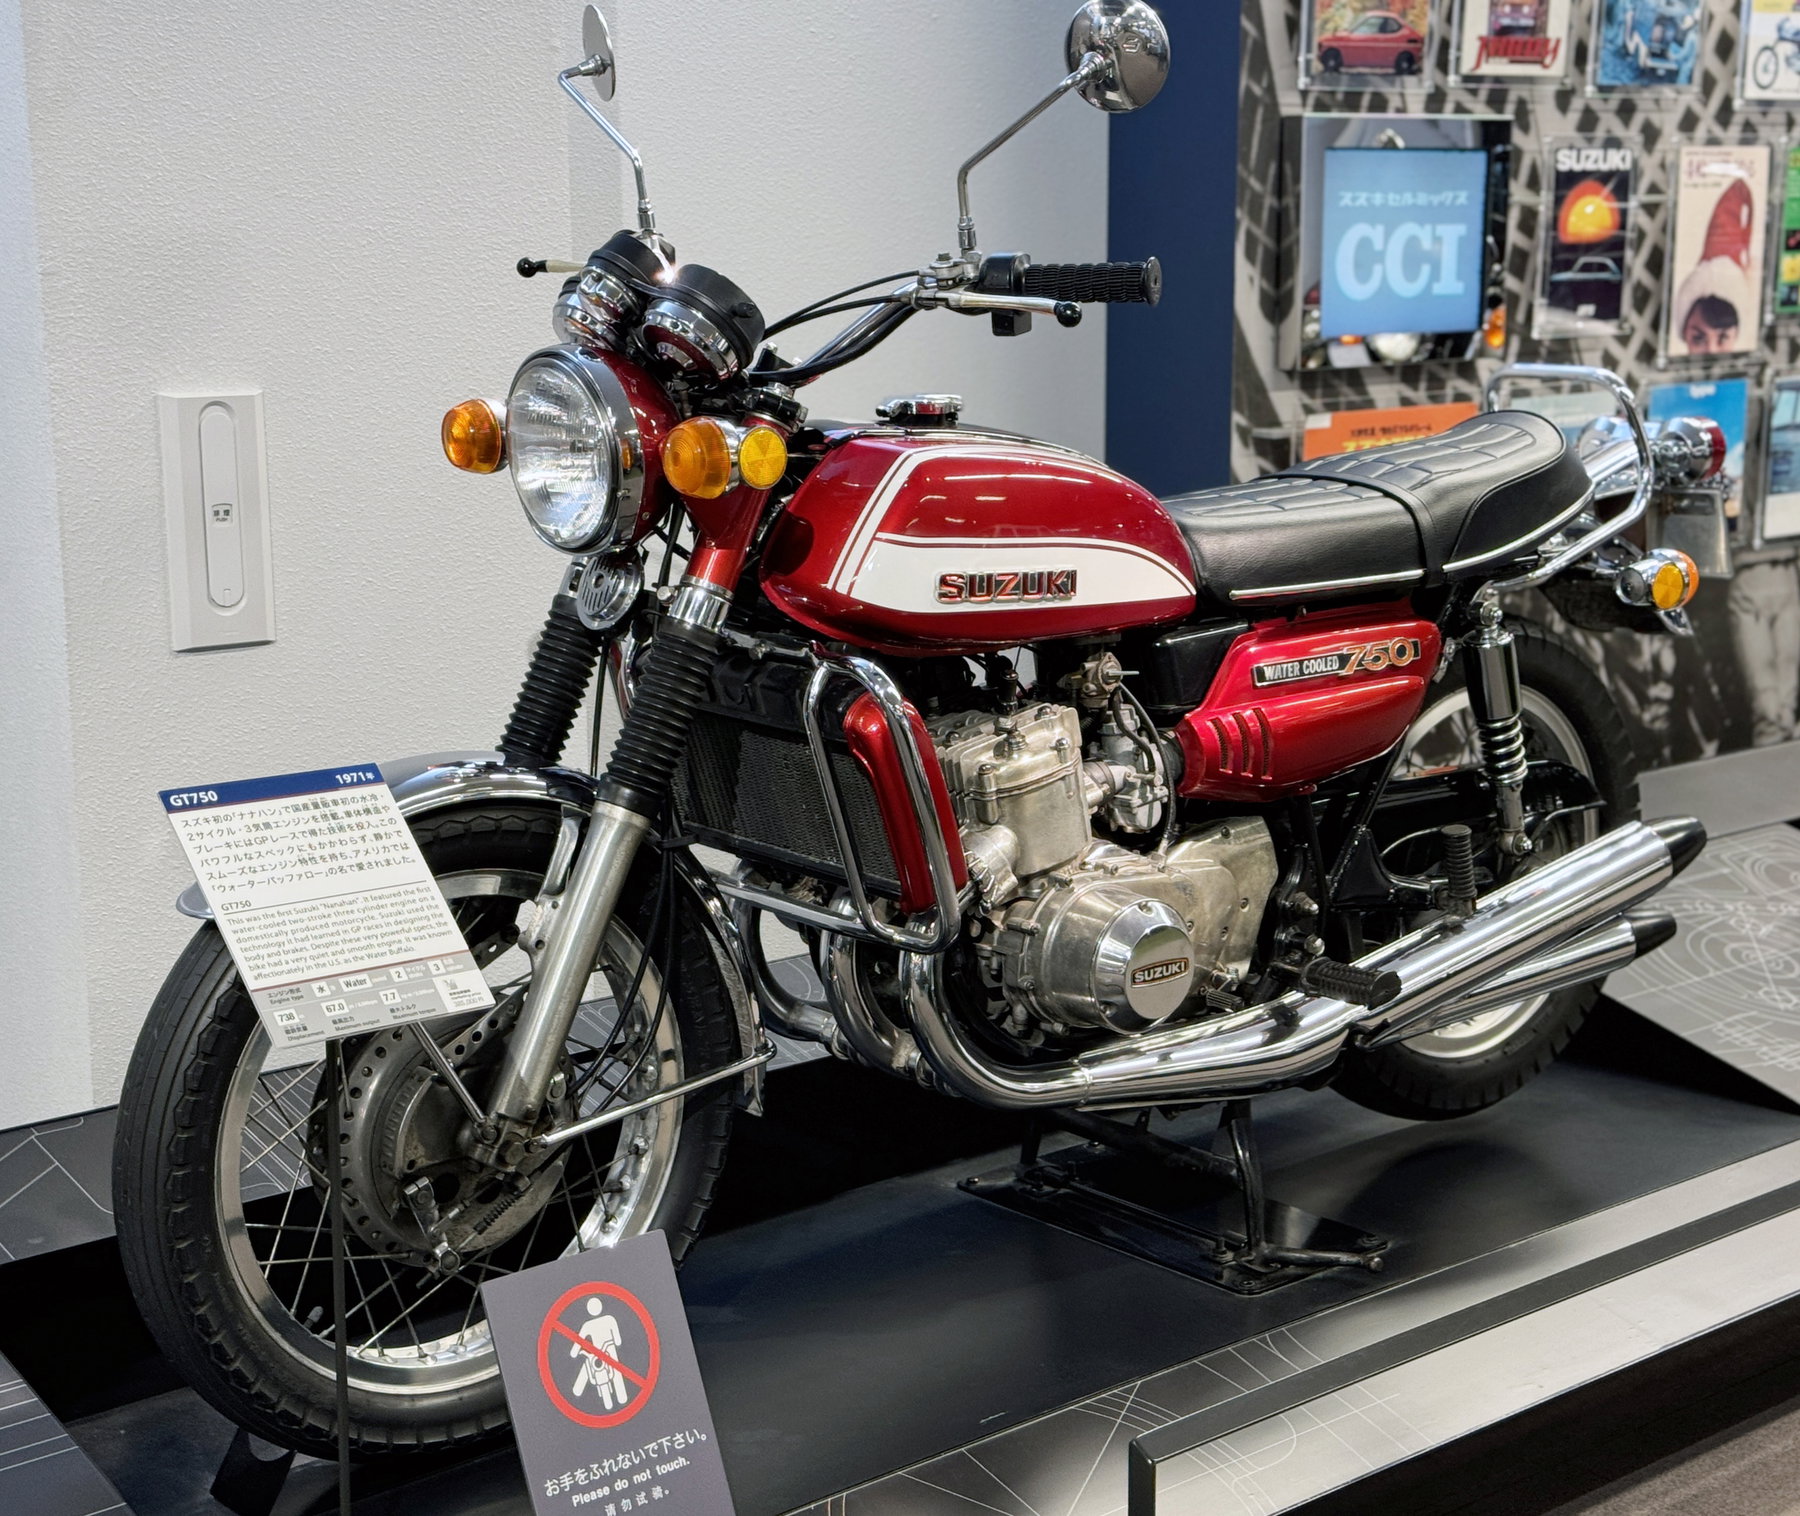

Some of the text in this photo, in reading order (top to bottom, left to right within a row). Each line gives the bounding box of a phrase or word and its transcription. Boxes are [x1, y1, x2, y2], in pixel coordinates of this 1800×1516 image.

[1556, 148, 1632, 171] SUZUKI
[1336, 222, 1467, 300] CCI
[936, 568, 1077, 604] SUZUKI
[1264, 637, 1414, 681] WATER COOLED 750
[336, 772, 375, 784] 1971年
[170, 791, 218, 806] GT750
[221, 900, 252, 911] GT750
[226, 918, 245, 926] This
[262, 912, 276, 920] the
[293, 905, 320, 915] Suzuki
[370, 891, 402, 901] featured
[333, 909, 355, 917] three
[357, 903, 388, 914] cylinder
[390, 899, 417, 908] engine
[236, 929, 288, 944] domestically
[290, 922, 330, 936] produced
[378, 909, 405, 919] Suzuki
[406, 905, 425, 914] used
[240, 941, 285, 953] technology
[294, 935, 310, 943] had
[310, 929, 341, 940] learned
[363, 923, 384, 931] races
[393, 915, 431, 926] designing
[244, 953, 265, 962] body
[266, 950, 282, 958] and
[310, 940, 340, 950] Despite
[340, 937, 361, 945] these
[248, 963, 266, 972] bike
[267, 959, 283, 968] had
[309, 952, 330, 961] quiet
[330, 948, 346, 957] and
[347, 943, 376, 954] smooth
[426, 930, 453, 939] known
[253, 966, 304, 981] affectionately
[365, 951, 387, 959] Water
[395, 971, 402, 979] 2
[433, 963, 440, 971] 3
[1134, 961, 1185, 983] SUZUKI
[317, 985, 326, 993] 水
[343, 979, 367, 988] Water
[383, 992, 396, 1001] 7.7
[278, 1012, 295, 1022] 738
[325, 1003, 345, 1013] 67.0
[544, 1428, 707, 1497] お手をふれないで下さい。
[571, 1456, 690, 1507] Please do not touch.
